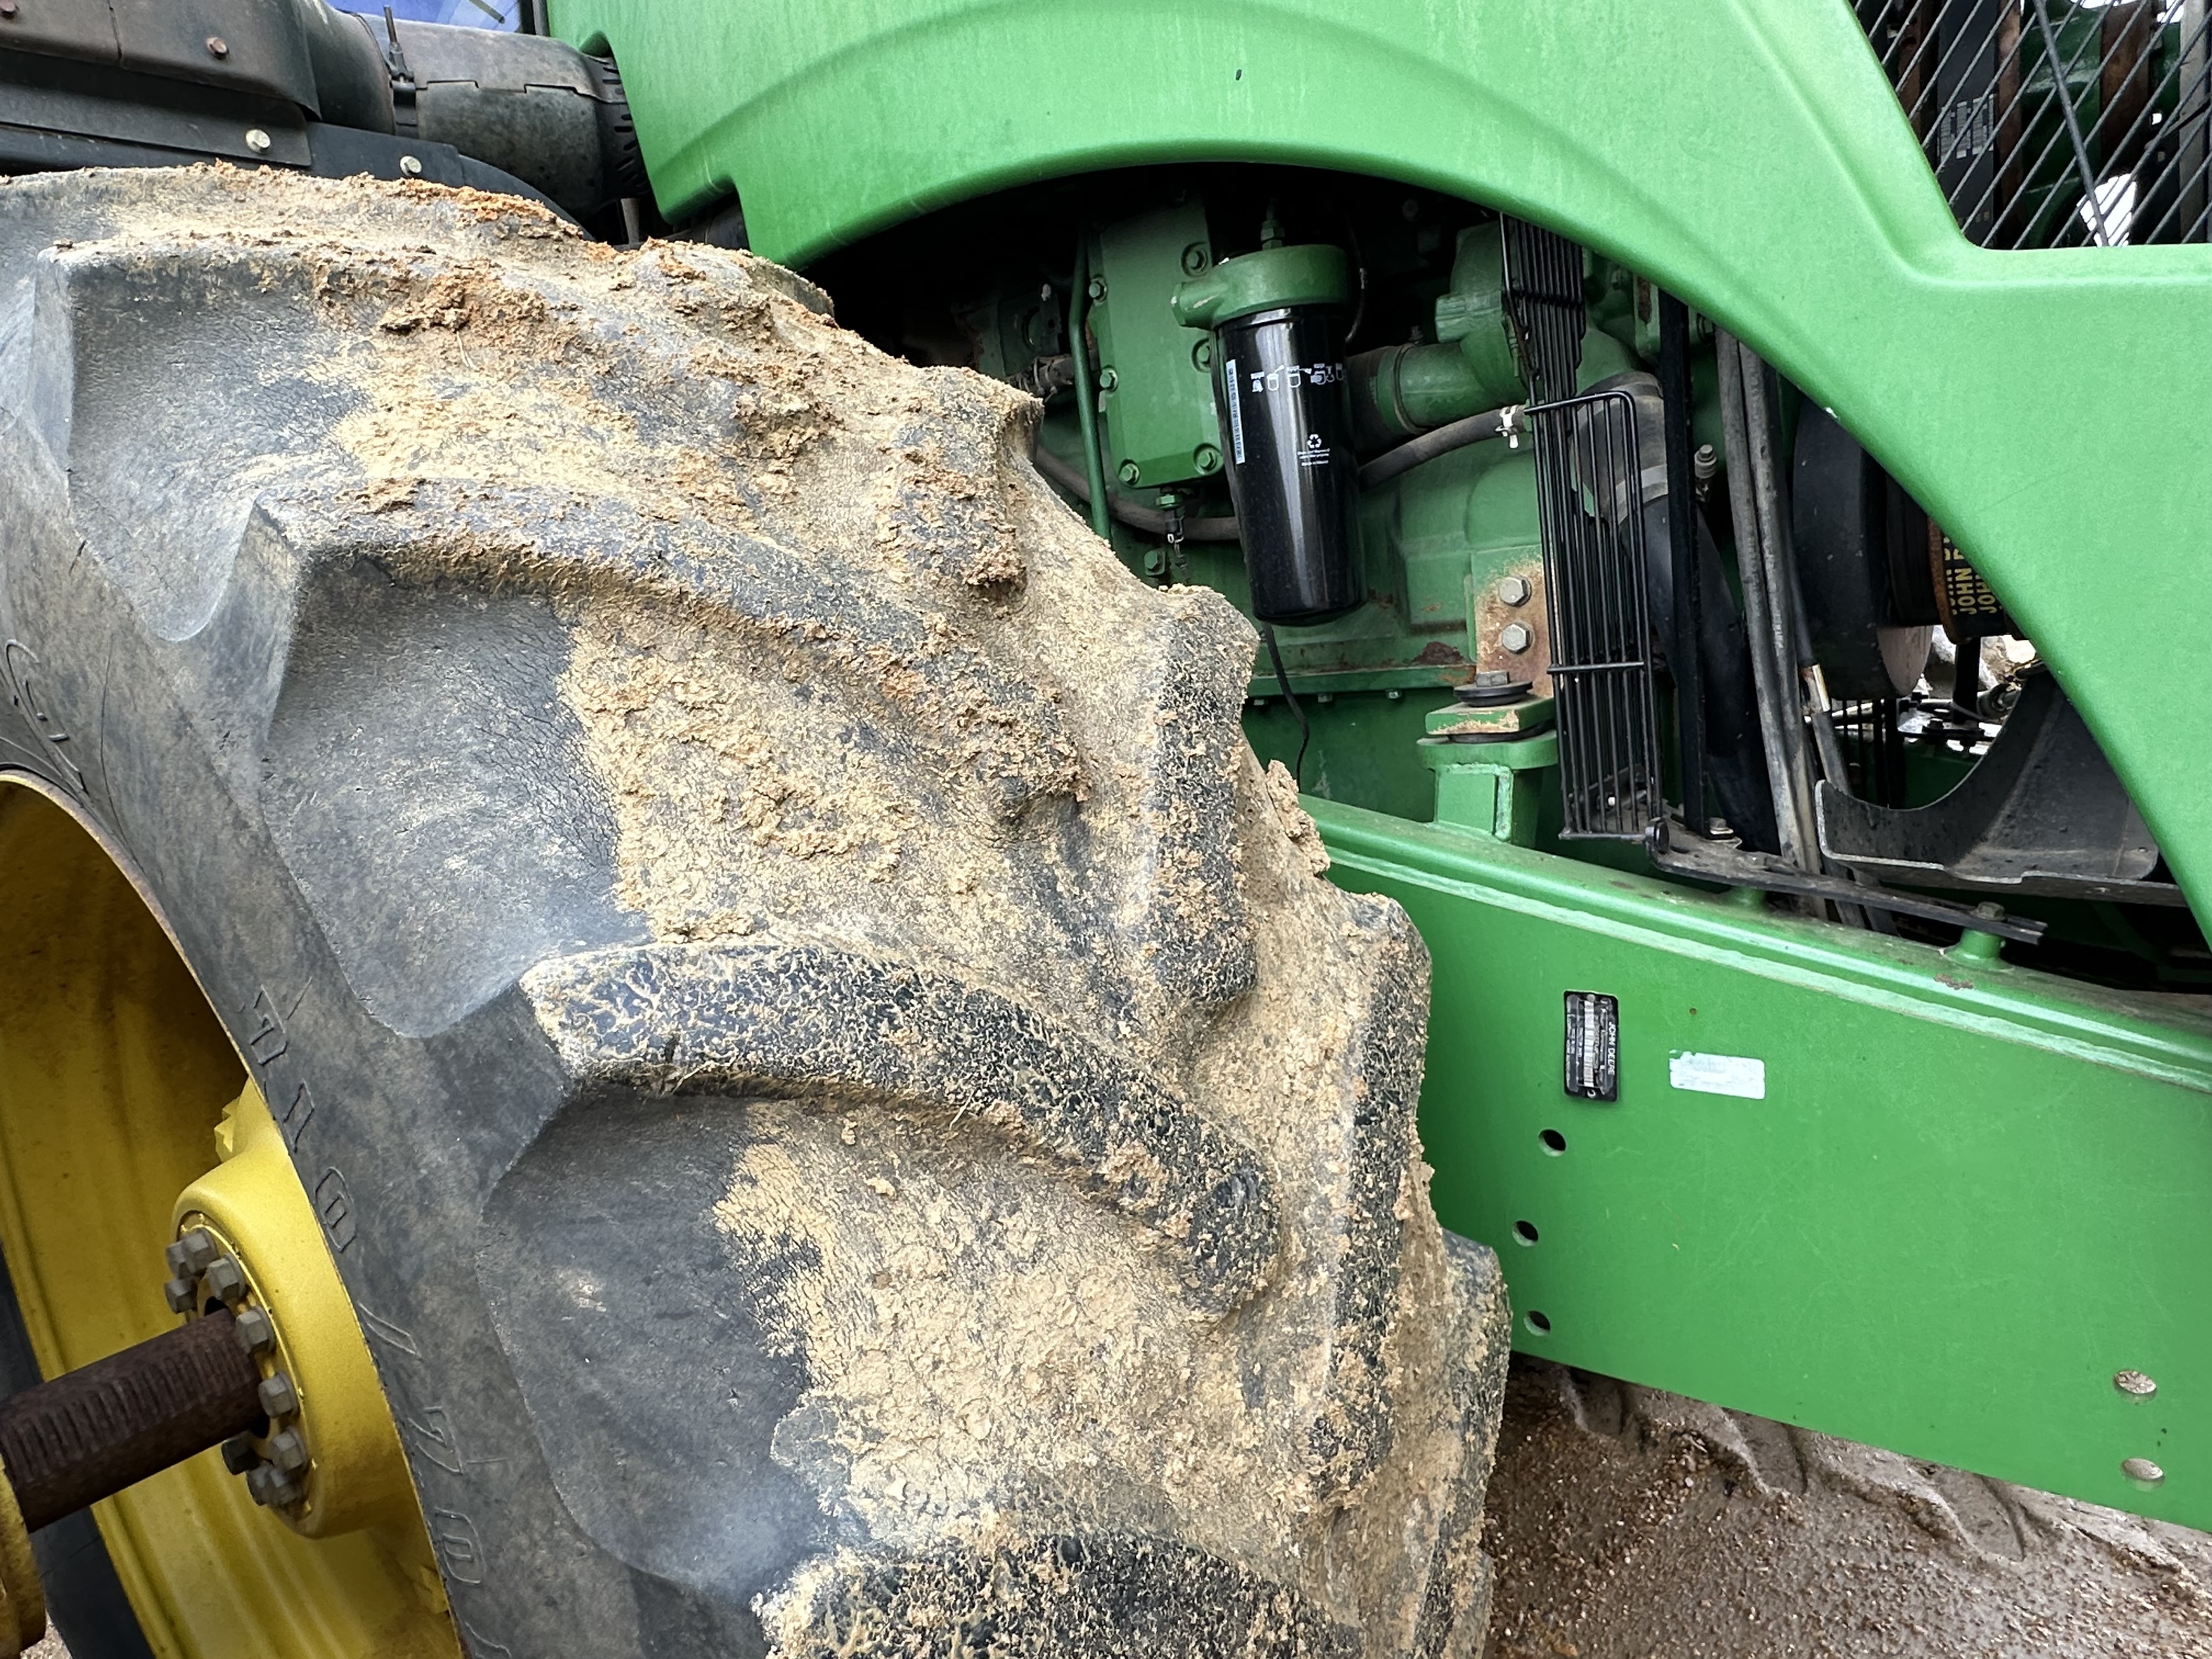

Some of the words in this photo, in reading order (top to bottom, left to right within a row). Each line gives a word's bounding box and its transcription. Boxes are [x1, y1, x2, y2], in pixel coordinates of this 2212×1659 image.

[1954, 568, 1977, 615] JOHN
[1975, 574, 1997, 613] JOH
[1607, 1048, 1616, 1075] DEERE
